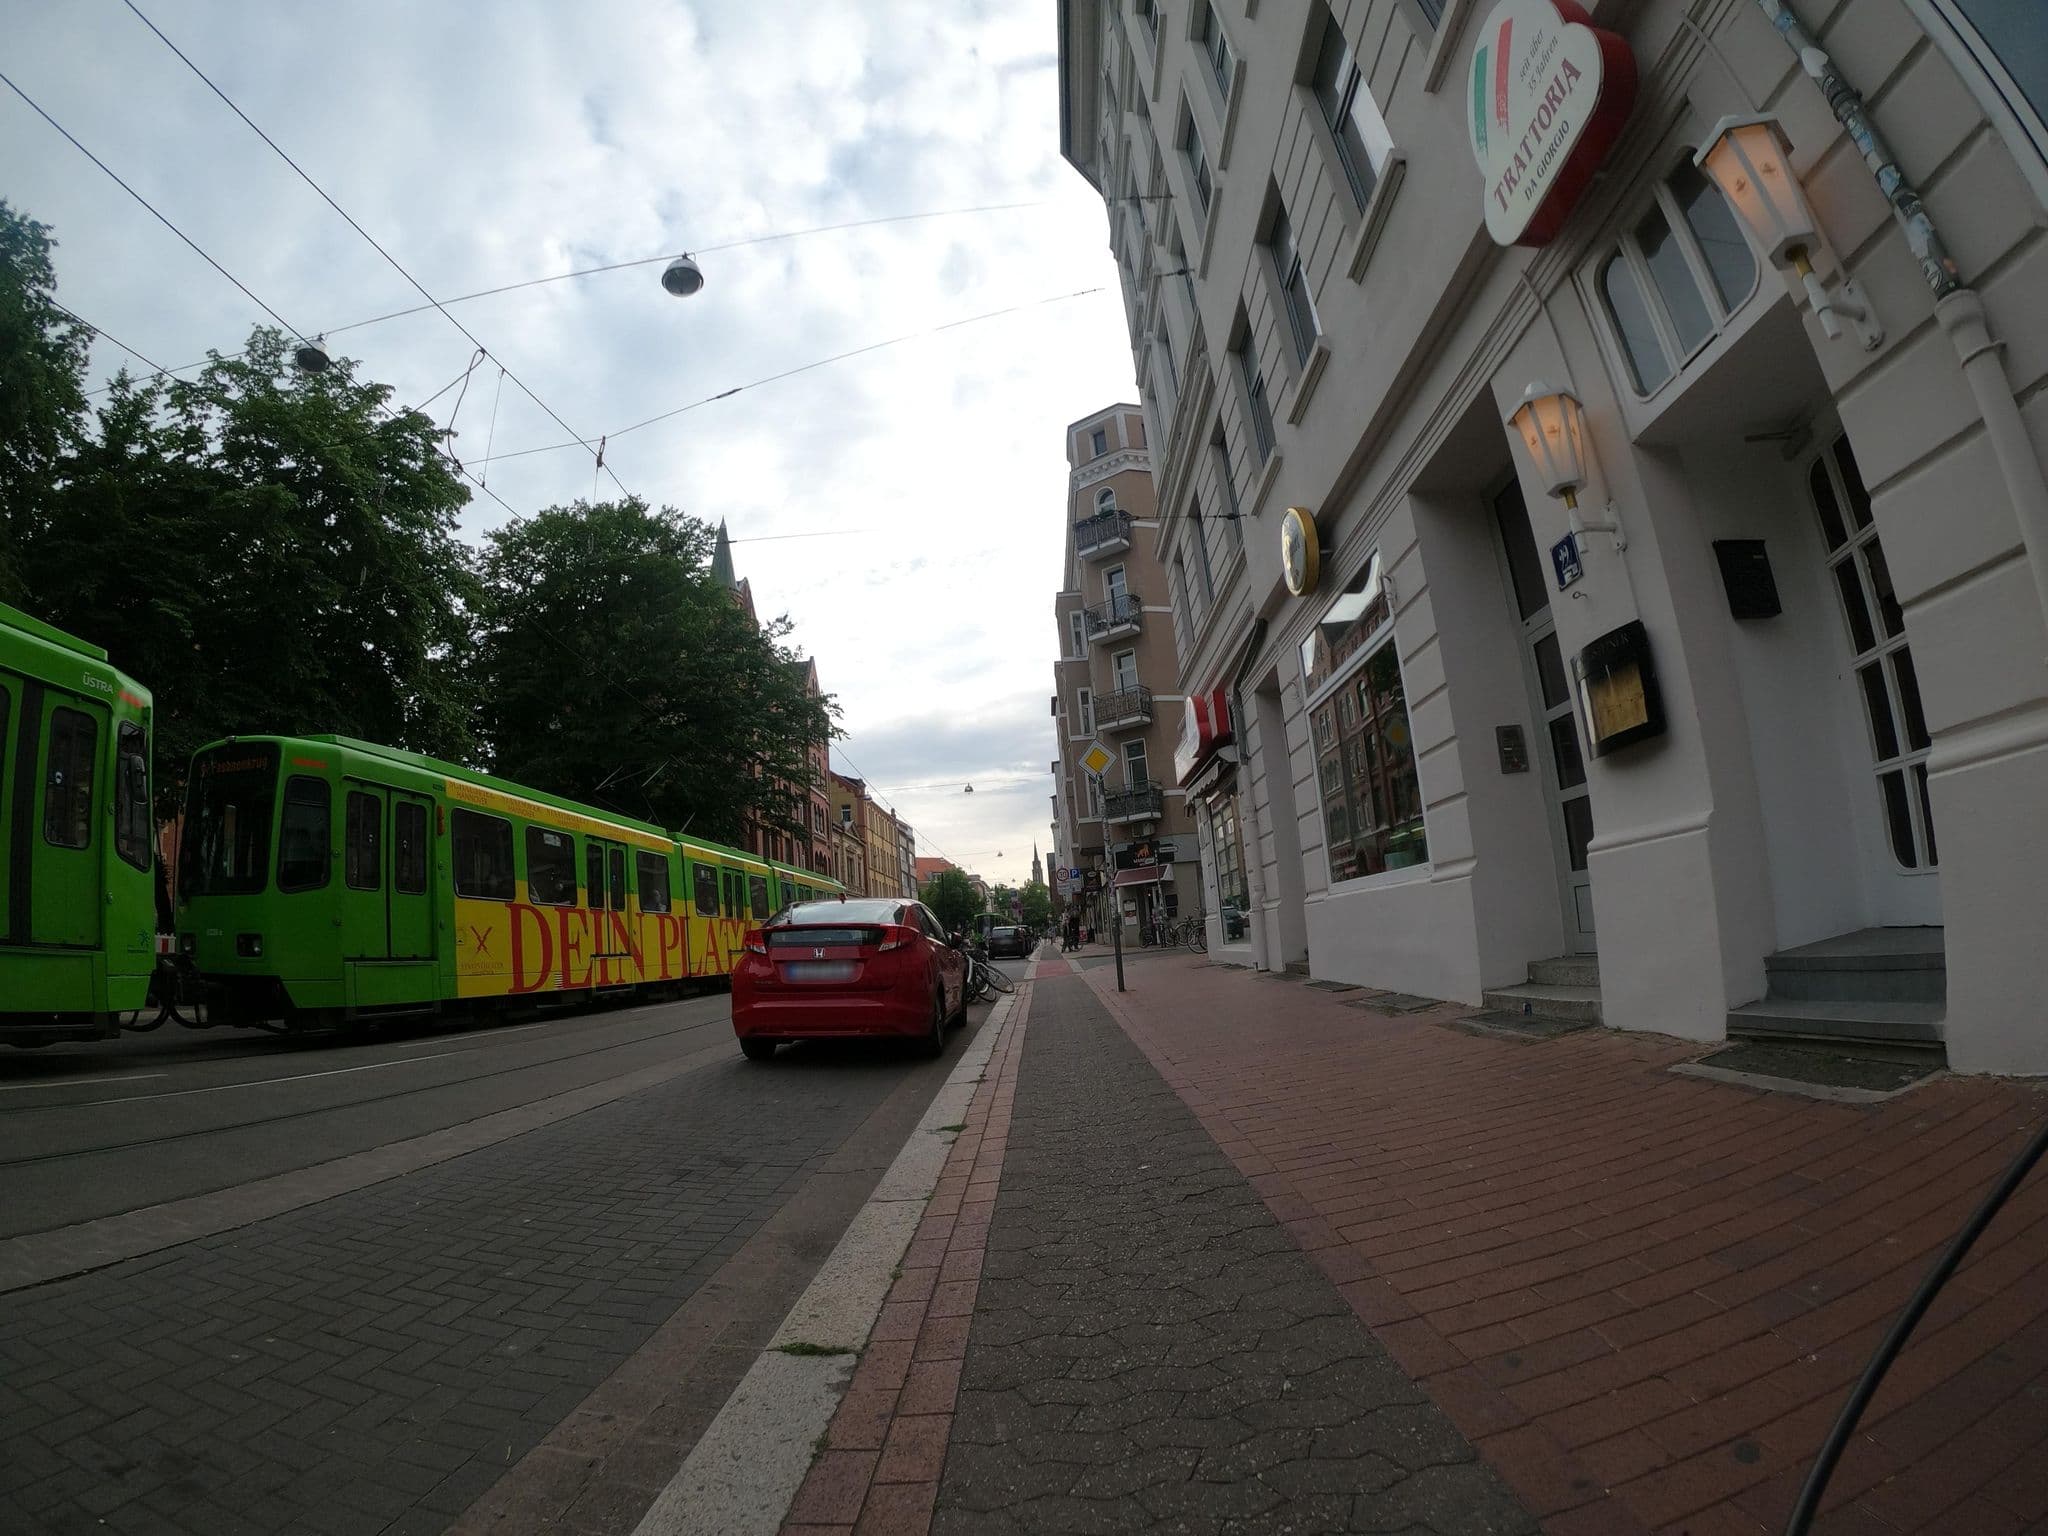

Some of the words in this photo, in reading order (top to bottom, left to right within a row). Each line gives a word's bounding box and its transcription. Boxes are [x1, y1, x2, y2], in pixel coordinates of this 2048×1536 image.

[1519, 57, 1531, 82] seit
[1530, 28, 1545, 59] über
[1536, 35, 1559, 83] Jahren
[1494, 58, 1582, 213] TRATTORIA
[1524, 180, 1538, 201] DA
[1537, 119, 1570, 180] GIORGIO
[83, 671, 114, 694] ÜSTRA
[505, 903, 645, 994] DEIN
